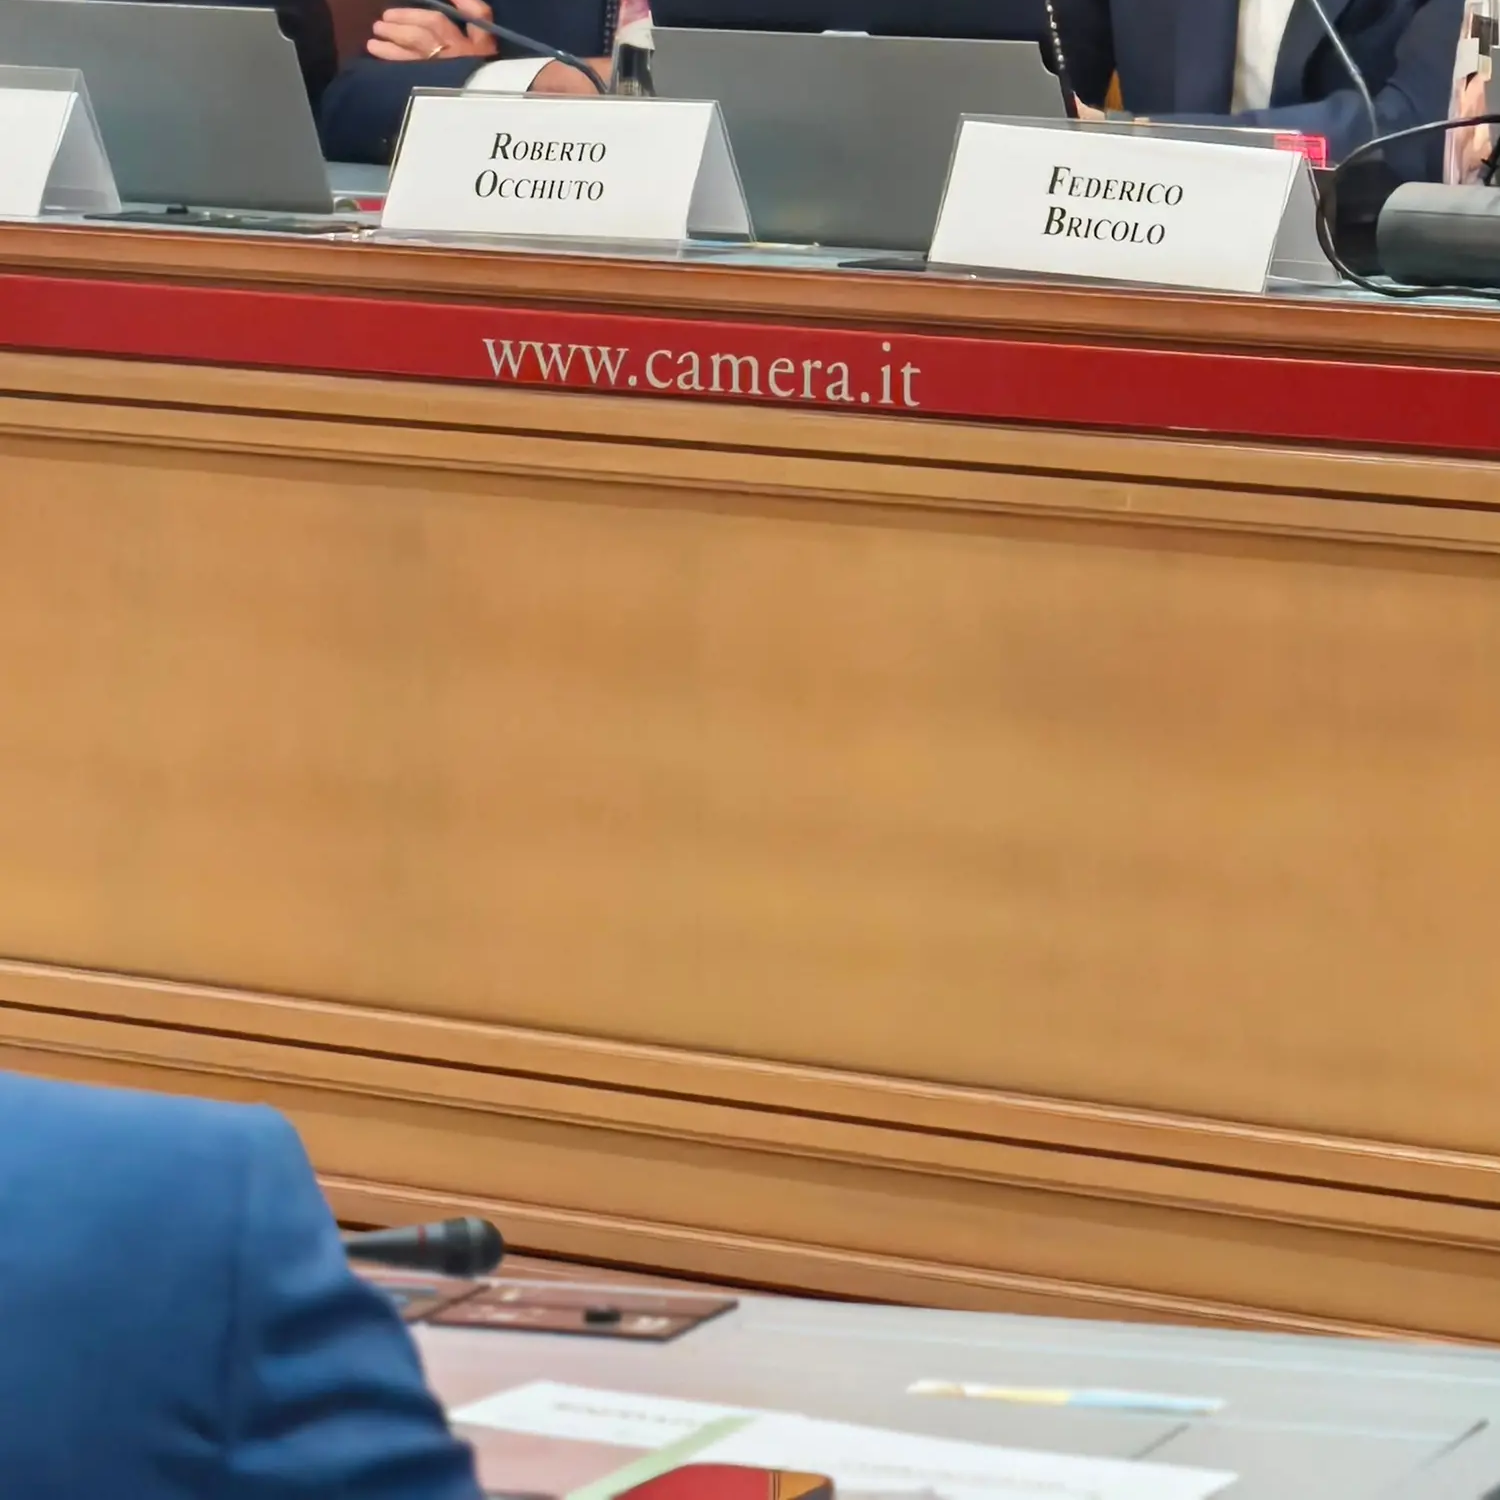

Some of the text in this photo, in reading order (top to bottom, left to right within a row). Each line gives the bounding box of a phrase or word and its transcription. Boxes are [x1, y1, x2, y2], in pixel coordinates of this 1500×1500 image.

[489, 131, 608, 164] ROBERTO
[475, 169, 605, 202] OCCHIUTO
[1046, 165, 1185, 207] FEDERICO
[1043, 206, 1167, 246] BRICOLO
[482, 338, 922, 407] www.camera.it
